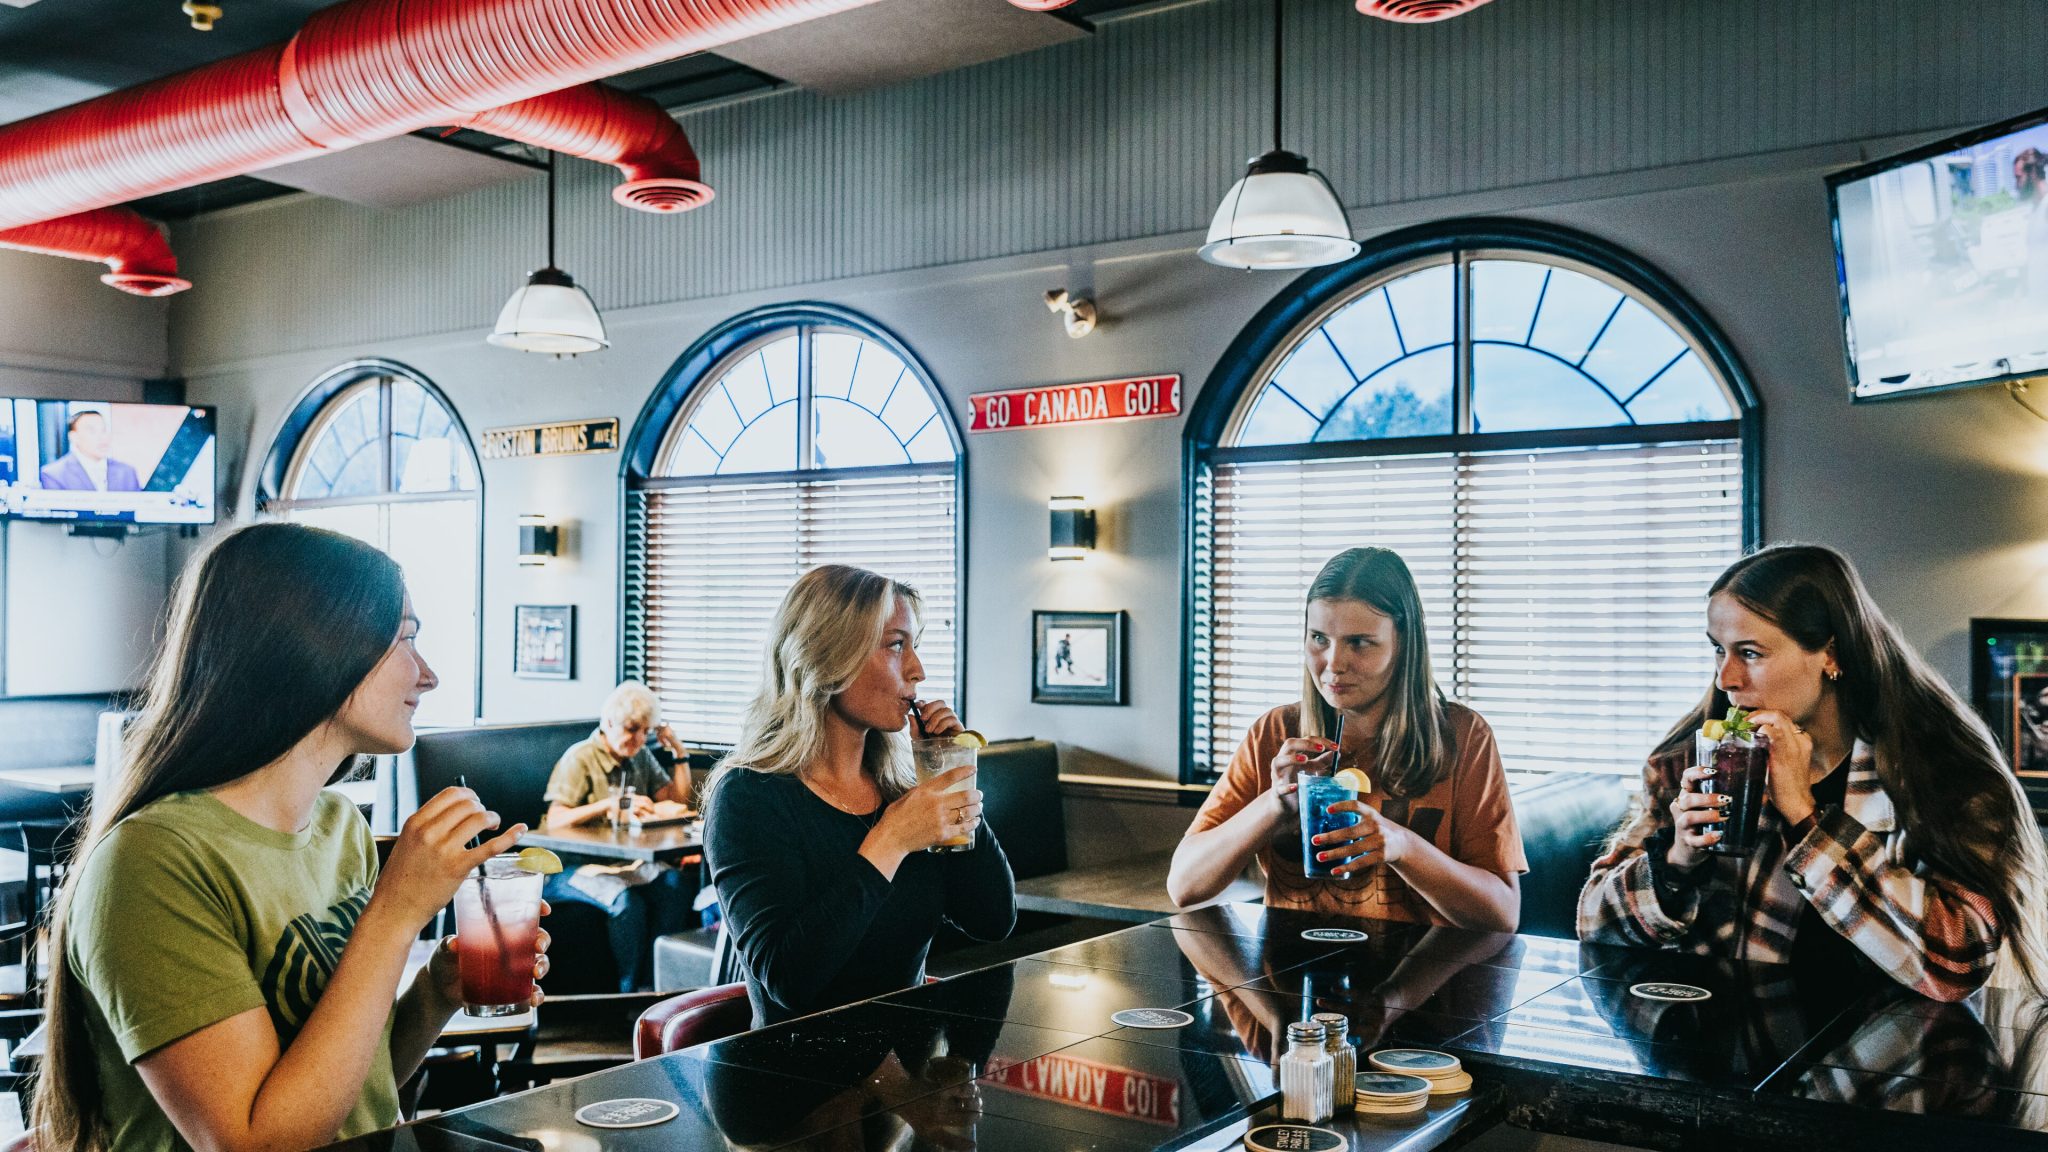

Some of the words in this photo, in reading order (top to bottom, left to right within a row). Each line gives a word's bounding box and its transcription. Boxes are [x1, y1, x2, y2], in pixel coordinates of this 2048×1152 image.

[985, 396, 1010, 428] GO
[1024, 386, 1109, 425] CANADA
[1124, 381, 1159, 416] GO!
[541, 425, 587, 454] BRUINS
[1277, 1129, 1290, 1149] STANLEY
